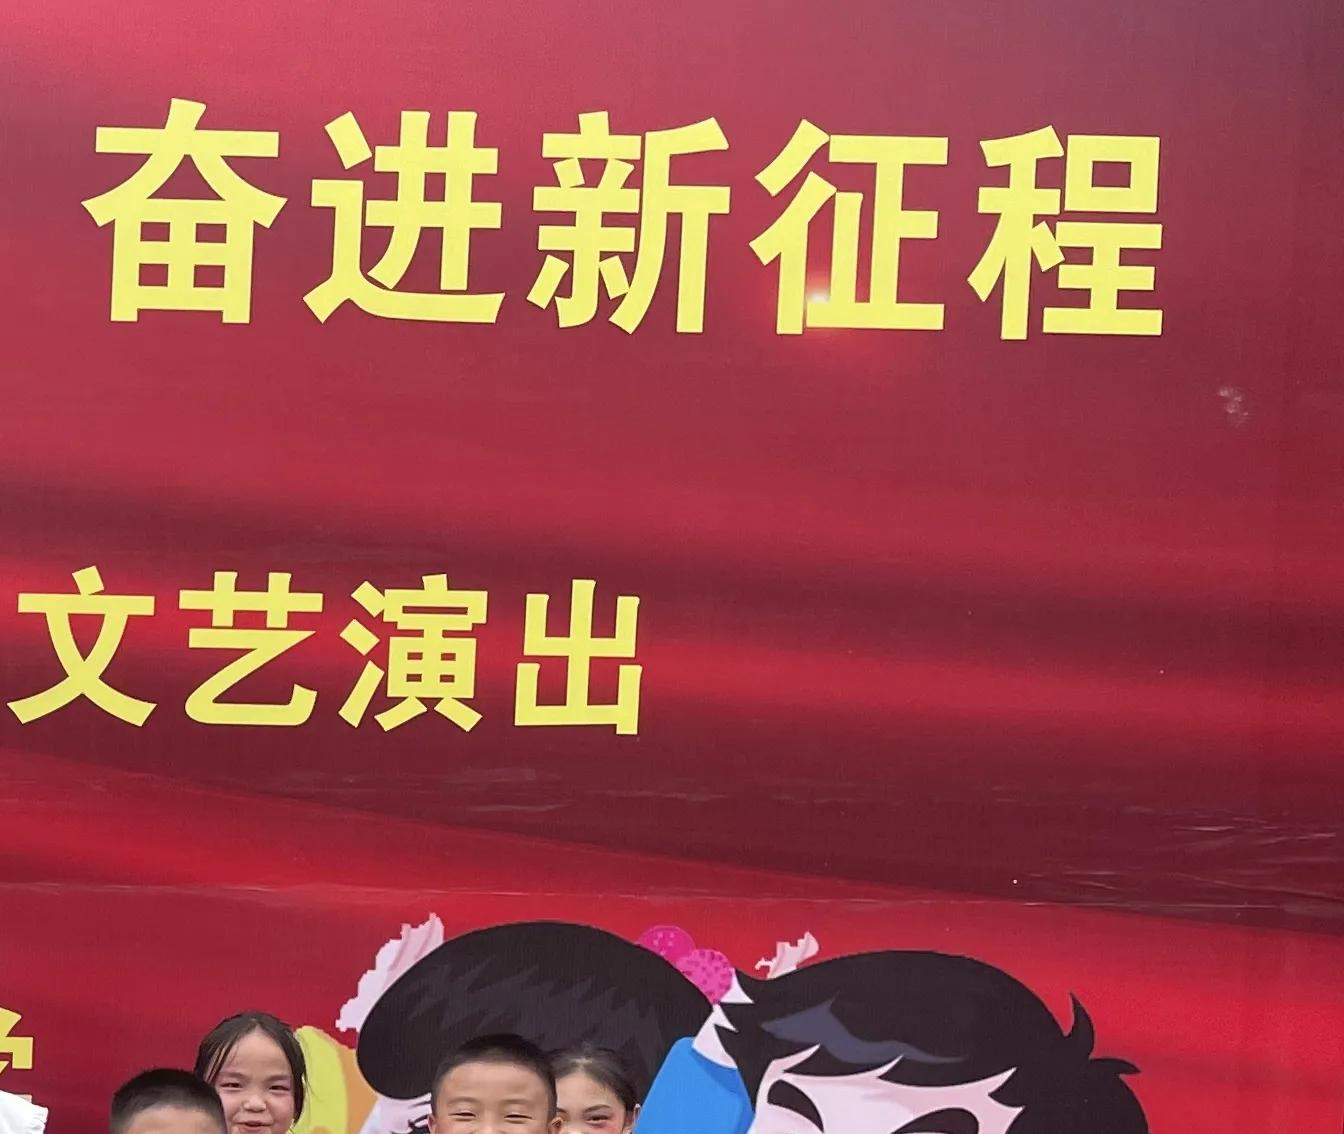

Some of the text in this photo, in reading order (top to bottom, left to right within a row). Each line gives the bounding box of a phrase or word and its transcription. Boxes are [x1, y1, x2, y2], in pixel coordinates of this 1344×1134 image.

[84, 100, 1163, 340] 奋进新征程
